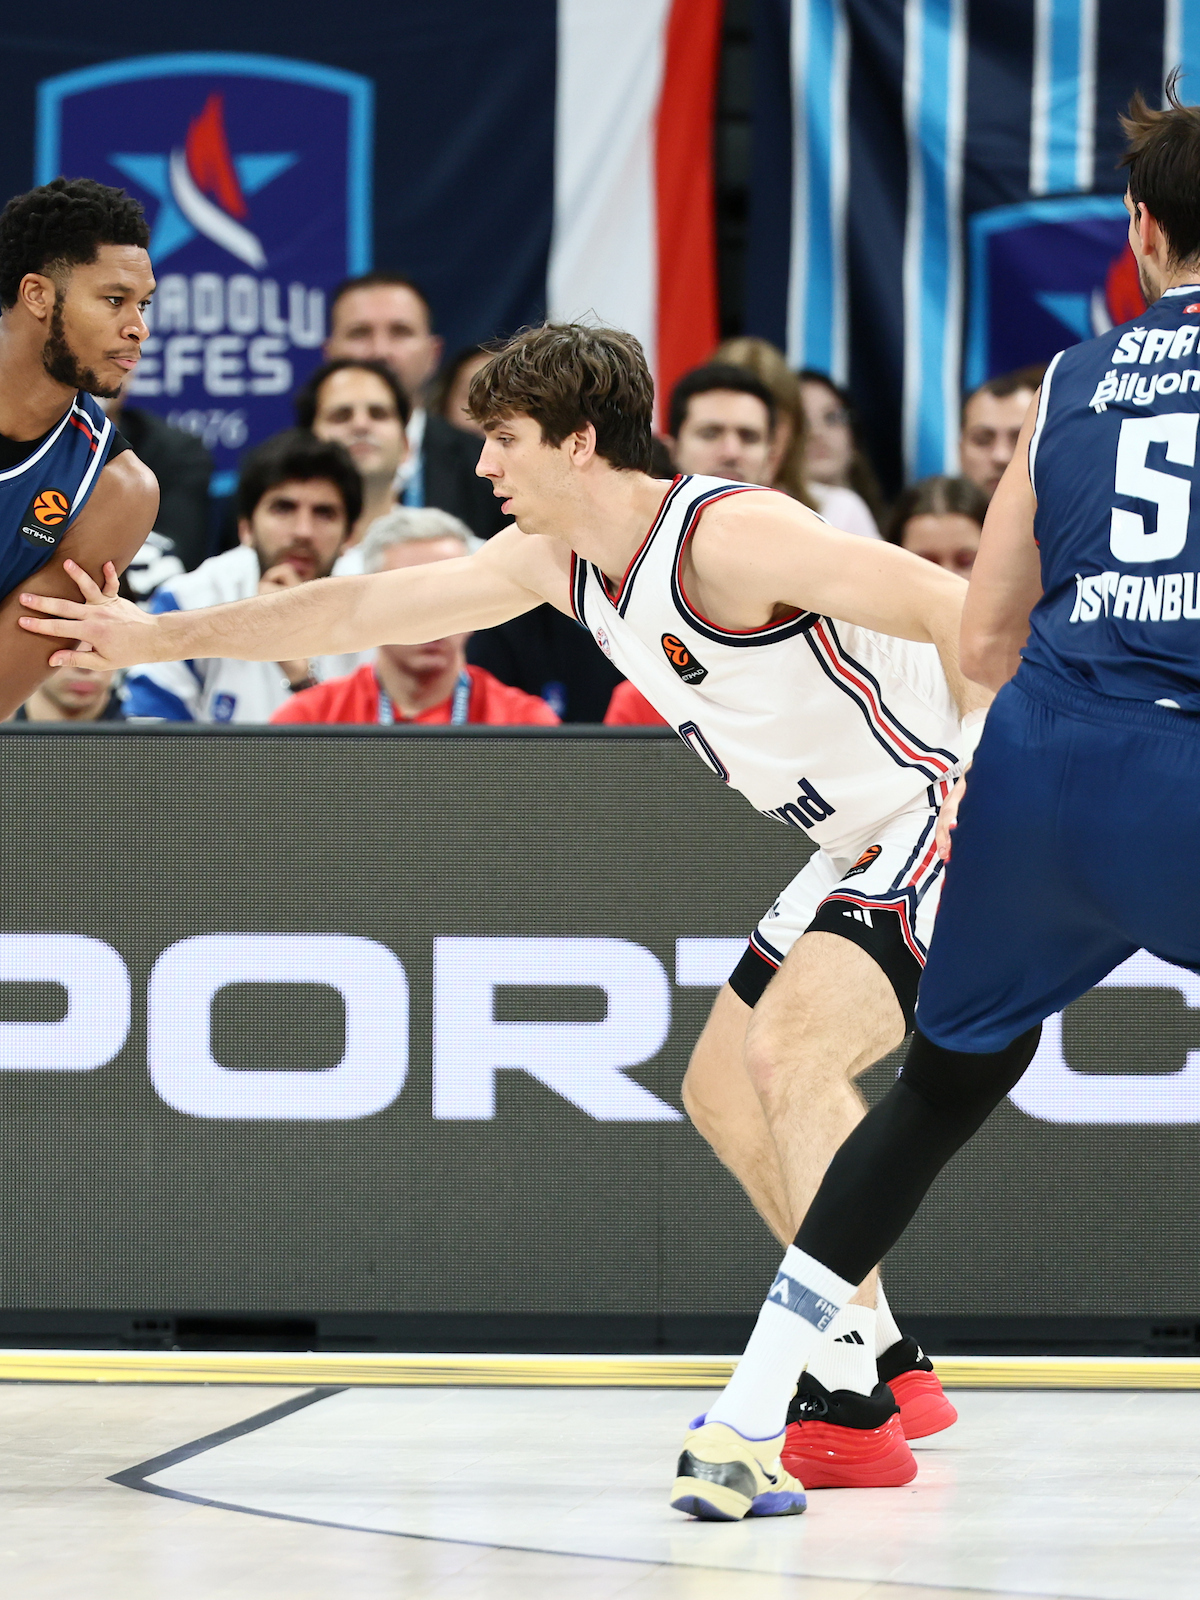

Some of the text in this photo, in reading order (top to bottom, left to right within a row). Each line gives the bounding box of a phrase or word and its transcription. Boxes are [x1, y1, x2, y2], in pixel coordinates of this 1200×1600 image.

[143, 272, 325, 348] ADOLU
[1111, 326, 1200, 365] ŠAR
[1110, 413, 1200, 563] 5
[22, 526, 55, 544] ETIHAD
